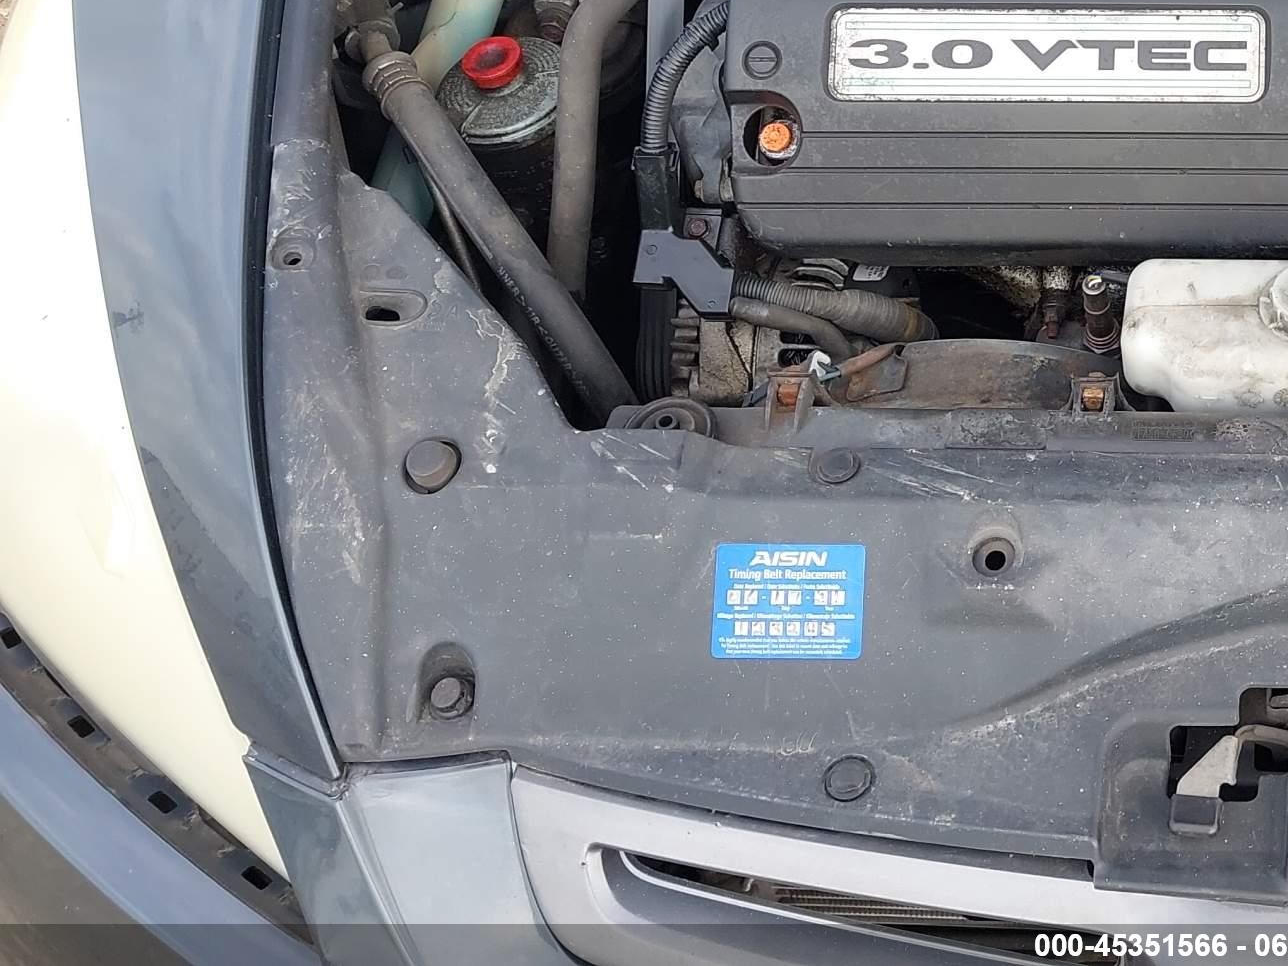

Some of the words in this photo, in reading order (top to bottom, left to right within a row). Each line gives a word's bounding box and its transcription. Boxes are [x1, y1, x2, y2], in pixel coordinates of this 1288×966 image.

[847, 38, 994, 71] 3.0
[1010, 38, 1248, 72] VTEC
[749, 550, 828, 567] AISIN
[728, 568, 762, 581] Timing
[763, 568, 783, 580] Belt
[785, 568, 847, 581] Replacement
